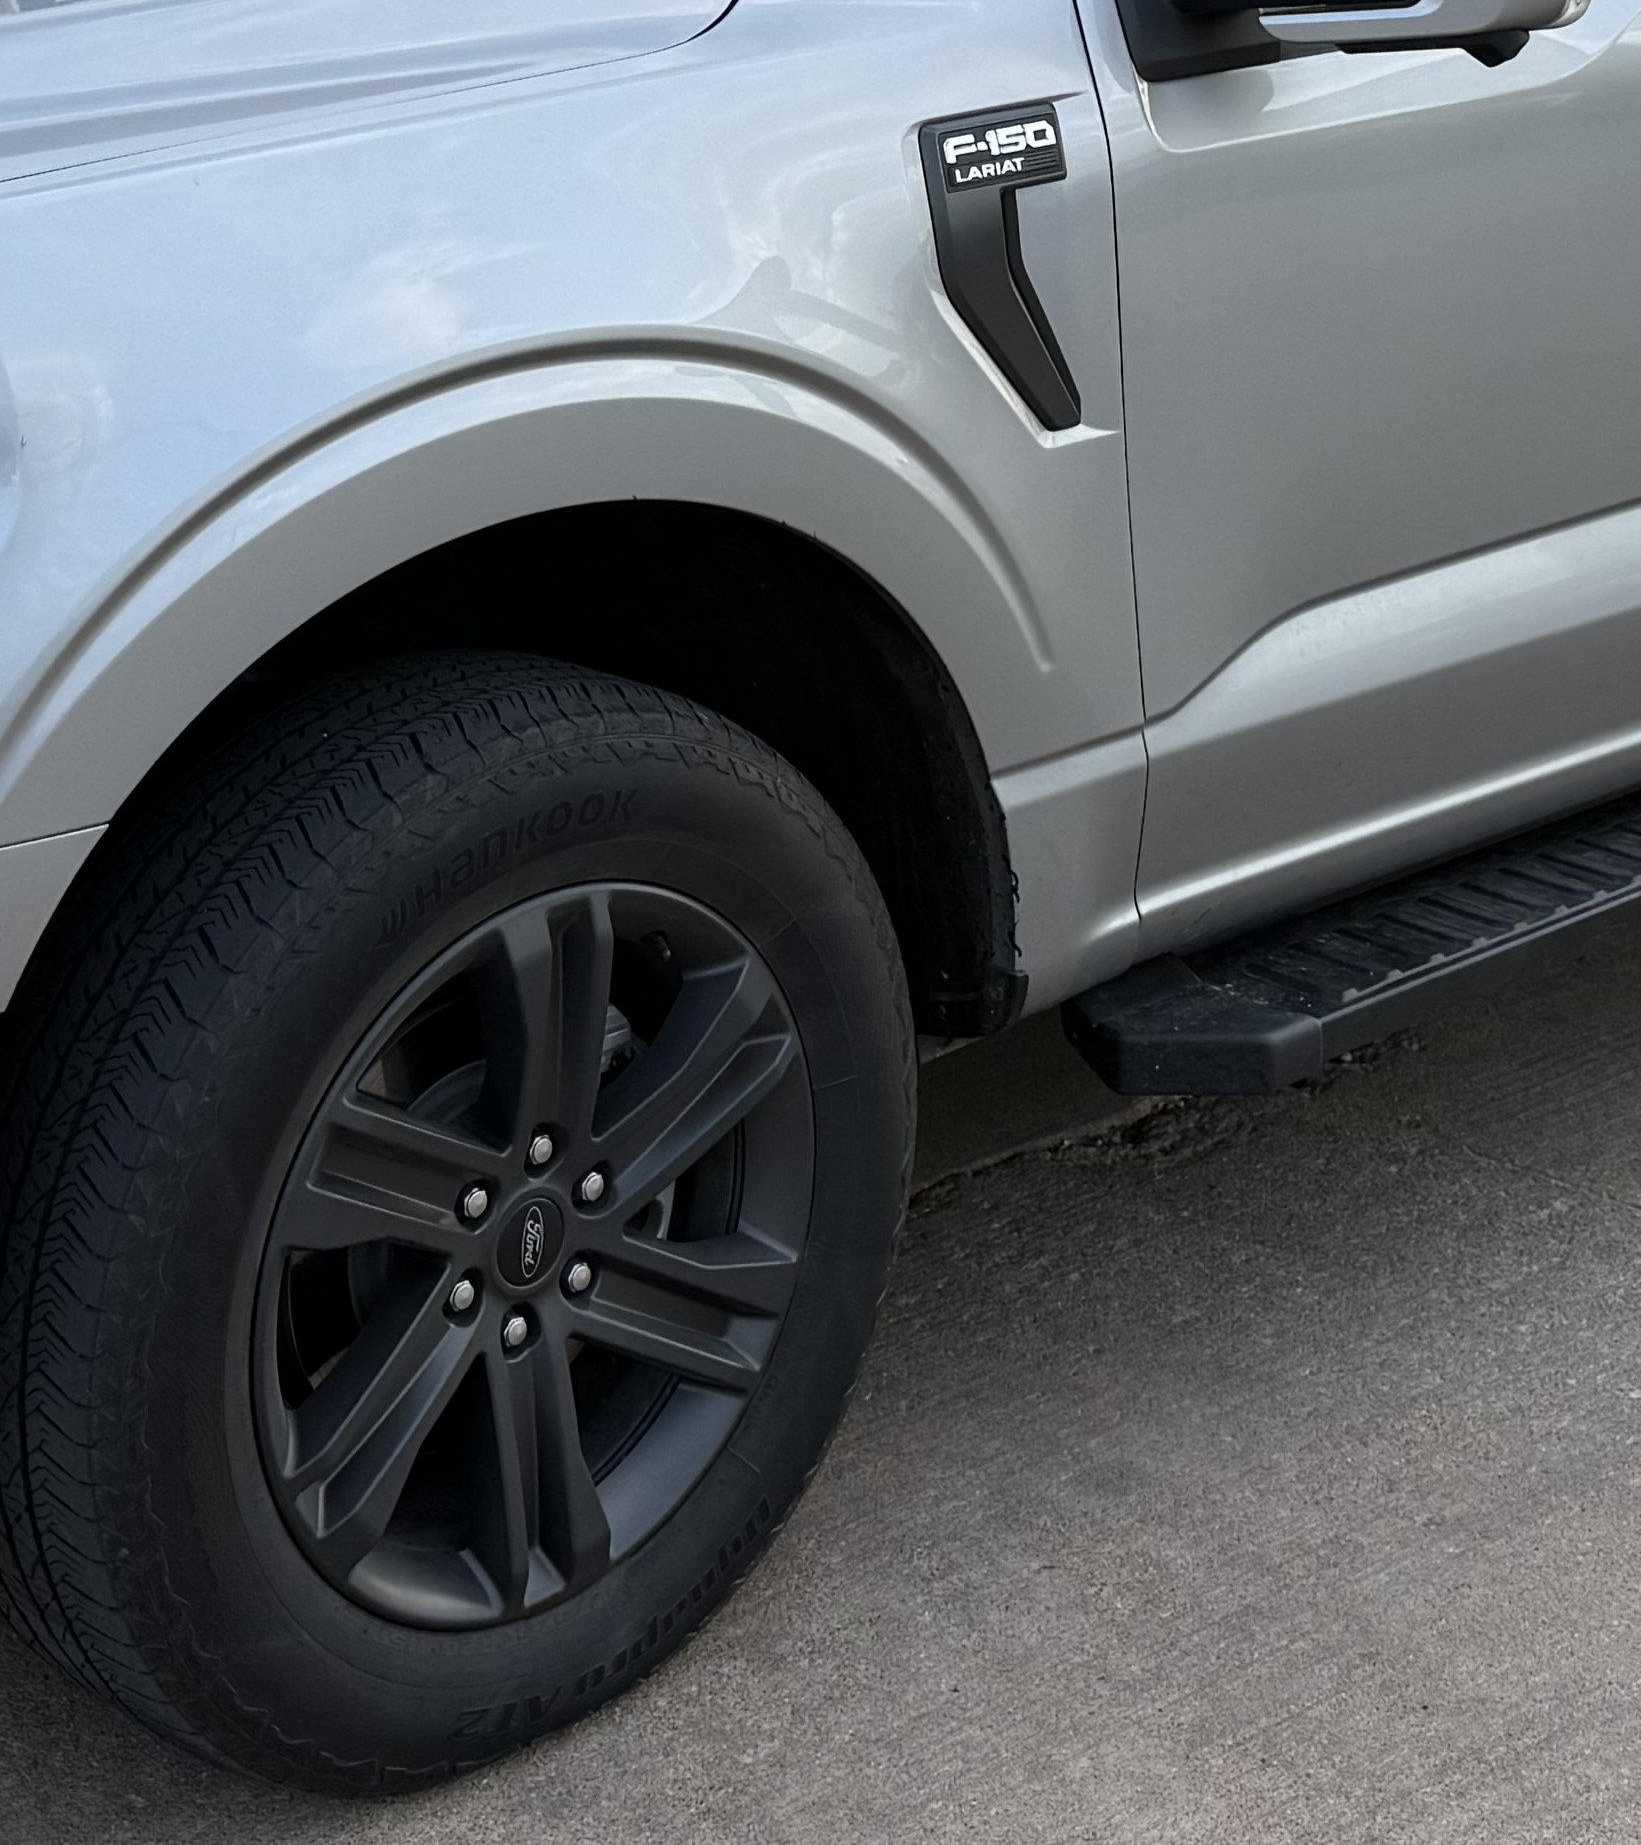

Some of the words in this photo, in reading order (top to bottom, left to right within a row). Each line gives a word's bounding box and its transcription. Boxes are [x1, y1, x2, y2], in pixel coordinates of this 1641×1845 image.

[944, 120, 1057, 164] F-150
[955, 157, 1024, 183] LARIAT
[524, 1219, 543, 1266] Ford
